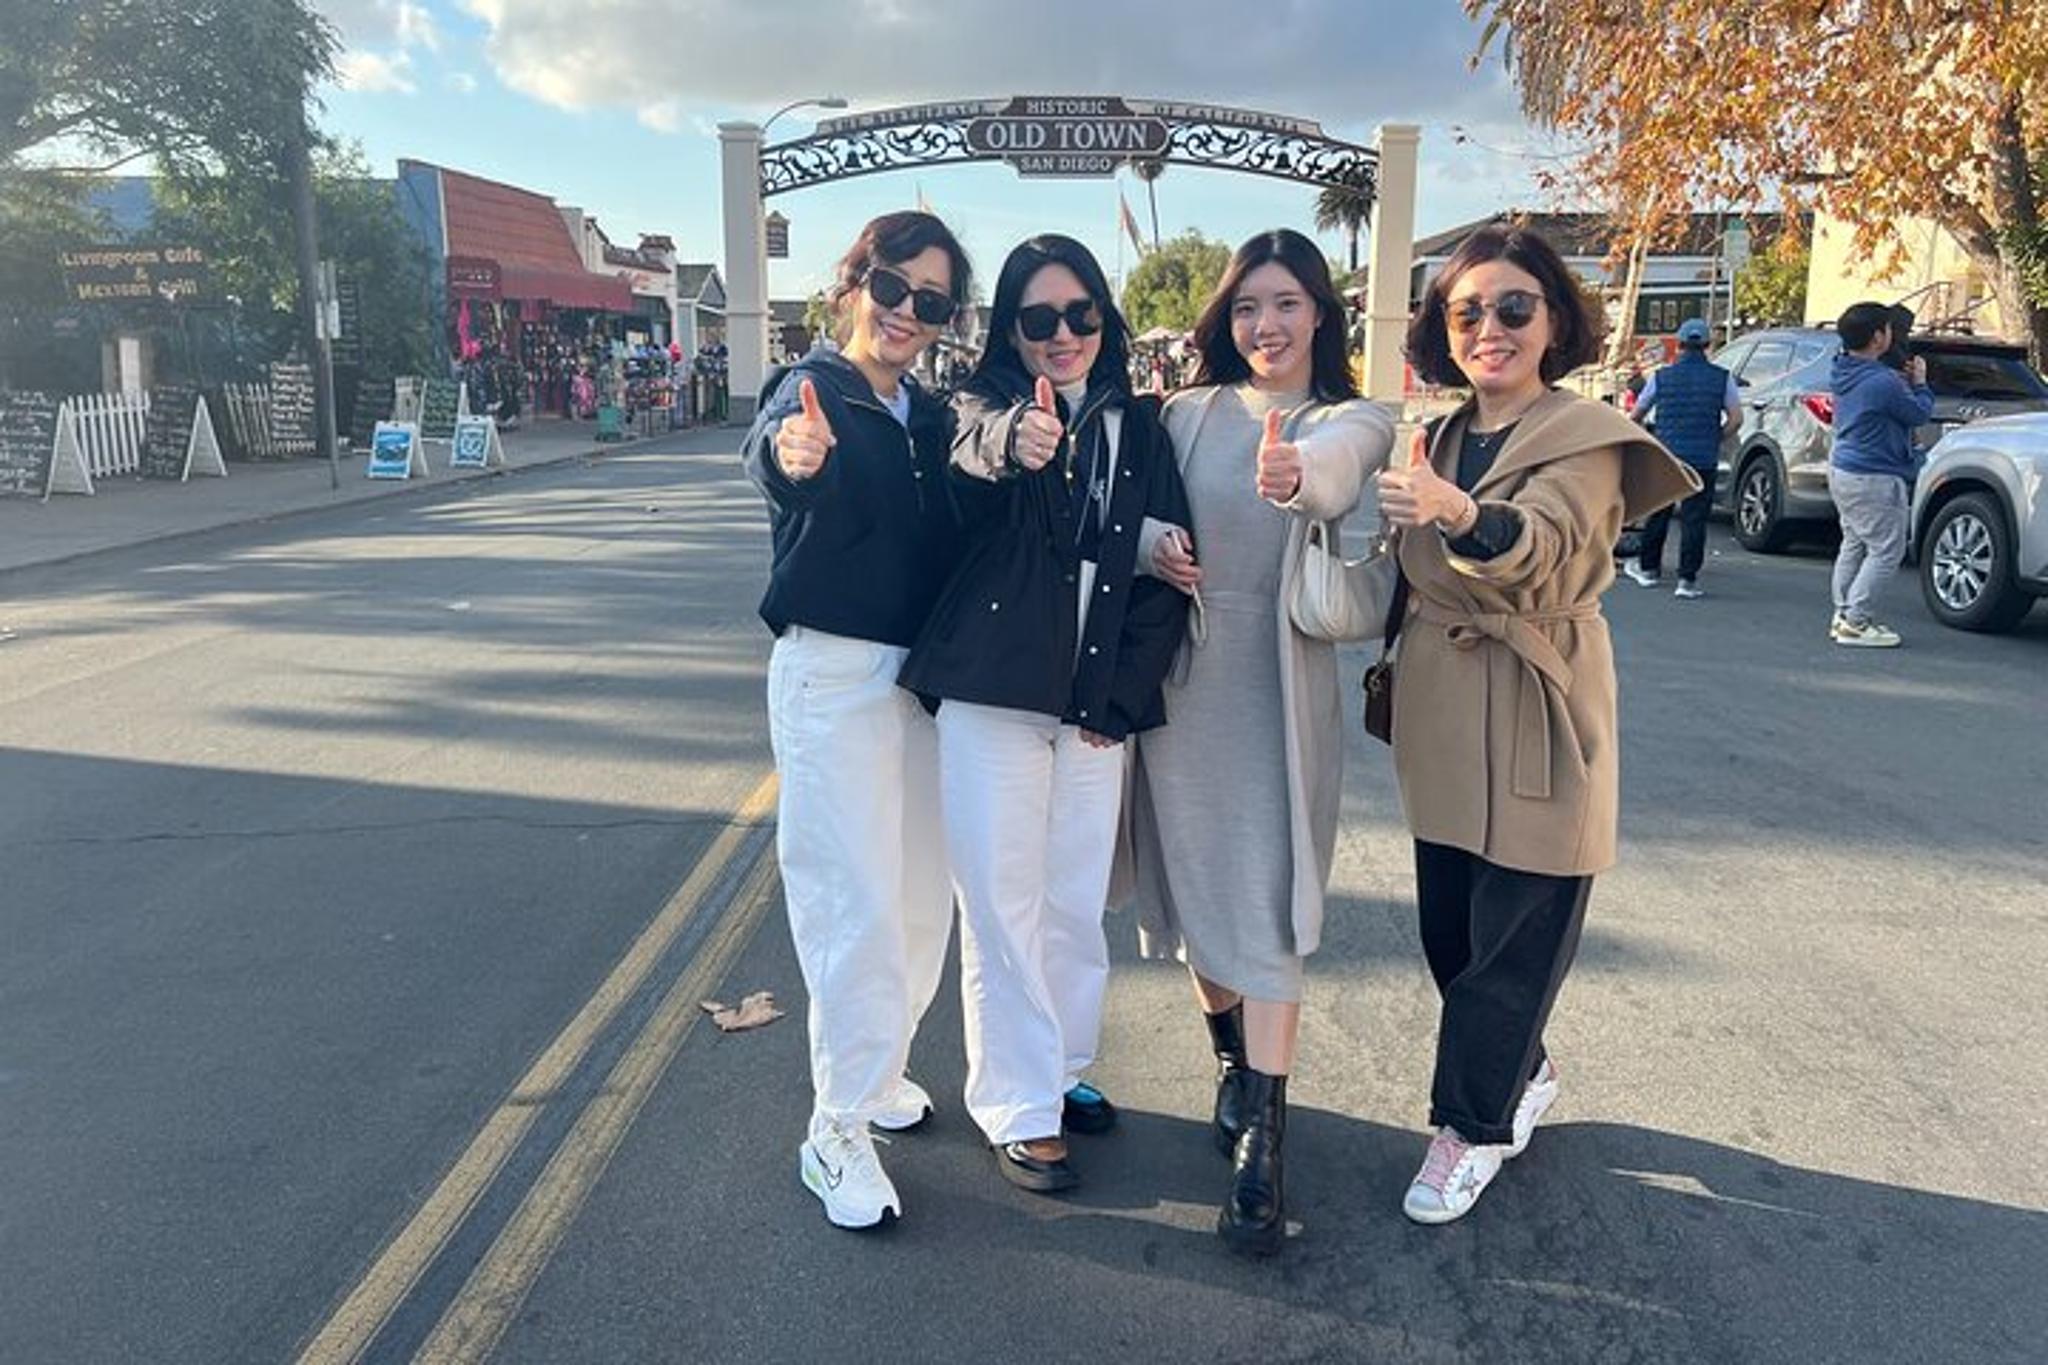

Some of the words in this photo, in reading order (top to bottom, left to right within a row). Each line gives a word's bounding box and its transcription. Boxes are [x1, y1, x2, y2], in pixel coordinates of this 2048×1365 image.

[1026, 101, 1107, 114] HISTORIC
[986, 122, 1046, 149] OLD
[1055, 122, 1147, 149] TOWN
[1021, 156, 1052, 170] SAN
[1058, 156, 1111, 171] DIEGO
